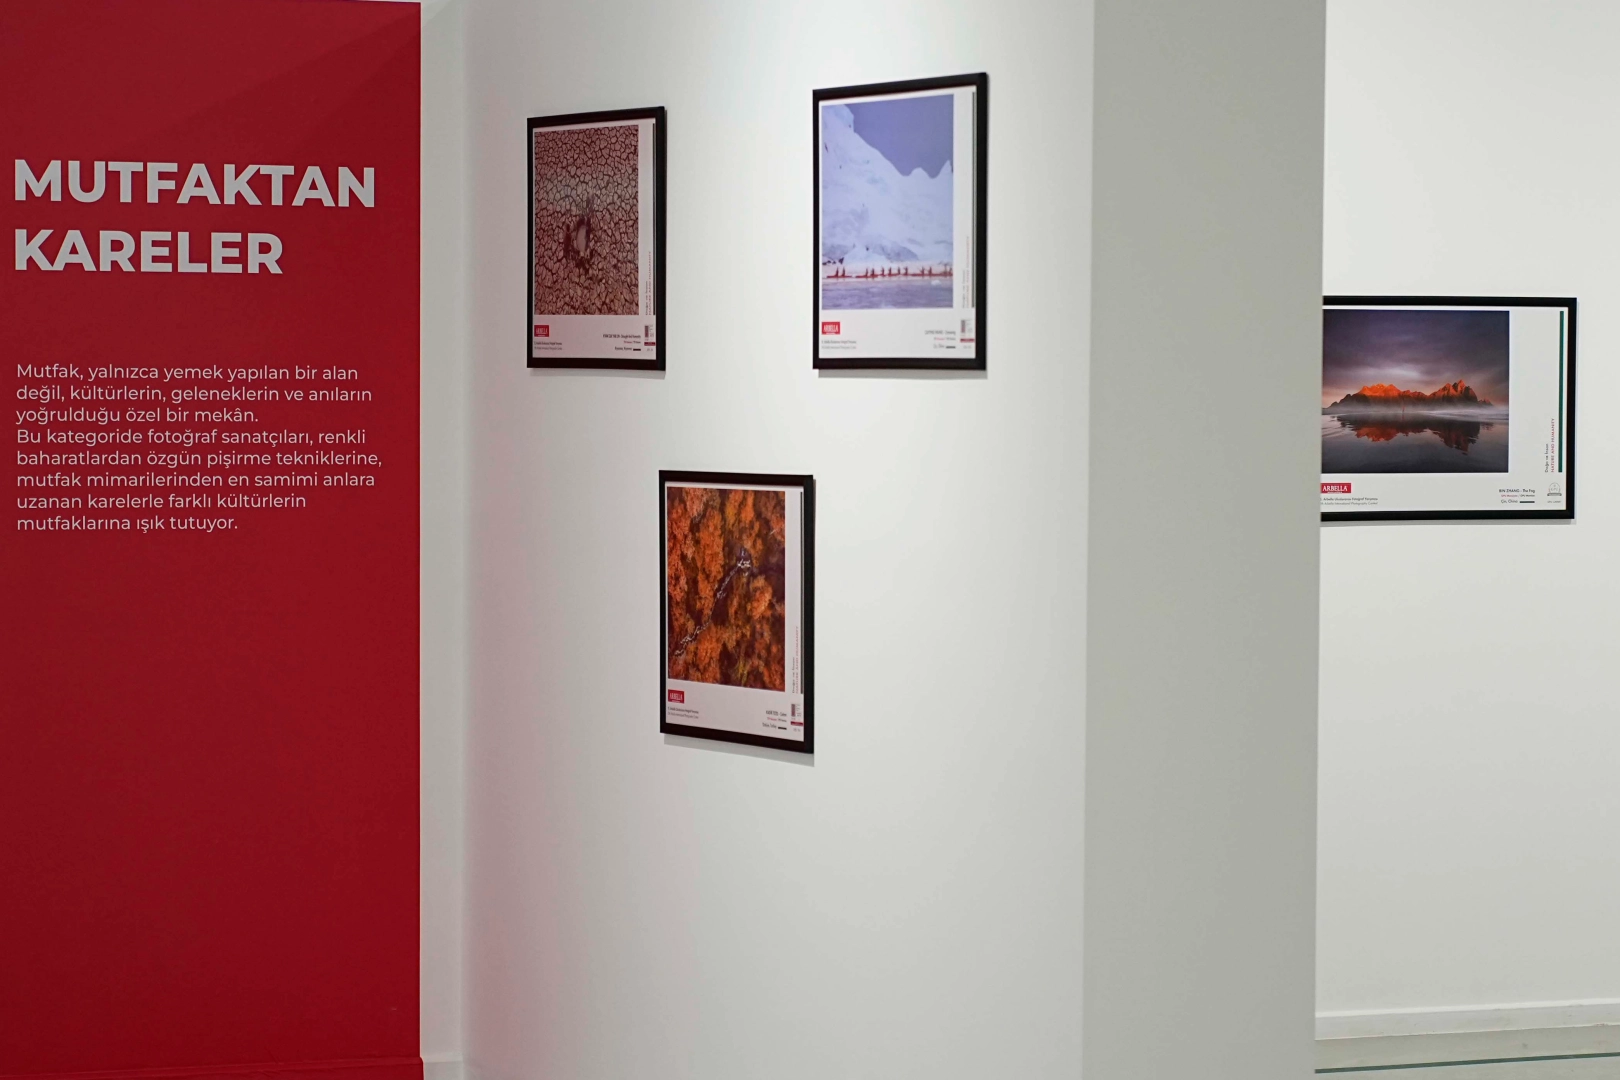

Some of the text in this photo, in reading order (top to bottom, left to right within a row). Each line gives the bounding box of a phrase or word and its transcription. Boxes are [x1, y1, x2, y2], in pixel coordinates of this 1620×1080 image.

[14, 158, 375, 208] MUTFAKTAN
[14, 228, 283, 275] KARELER
[17, 363, 358, 383] Mutfak, yalnızca yemek yapılan bir alan
[16, 384, 372, 404] değil, kültürlerin, geleneklerin ve anıların
[15, 406, 259, 426] yoğrulduğu özel bir mekân.
[17, 428, 366, 447] Bu kategoride fotoğraf sanatçıları, renkli
[17, 450, 382, 469] baharatlardan özgün pişirme tekniklerine,
[17, 471, 375, 487] mutfak mimarilerinden en samimi anlara
[17, 492, 306, 509] uzanan karelerle farklı kültürlerin
[17, 514, 238, 534] mutfaklarına ışık tutuyor.
